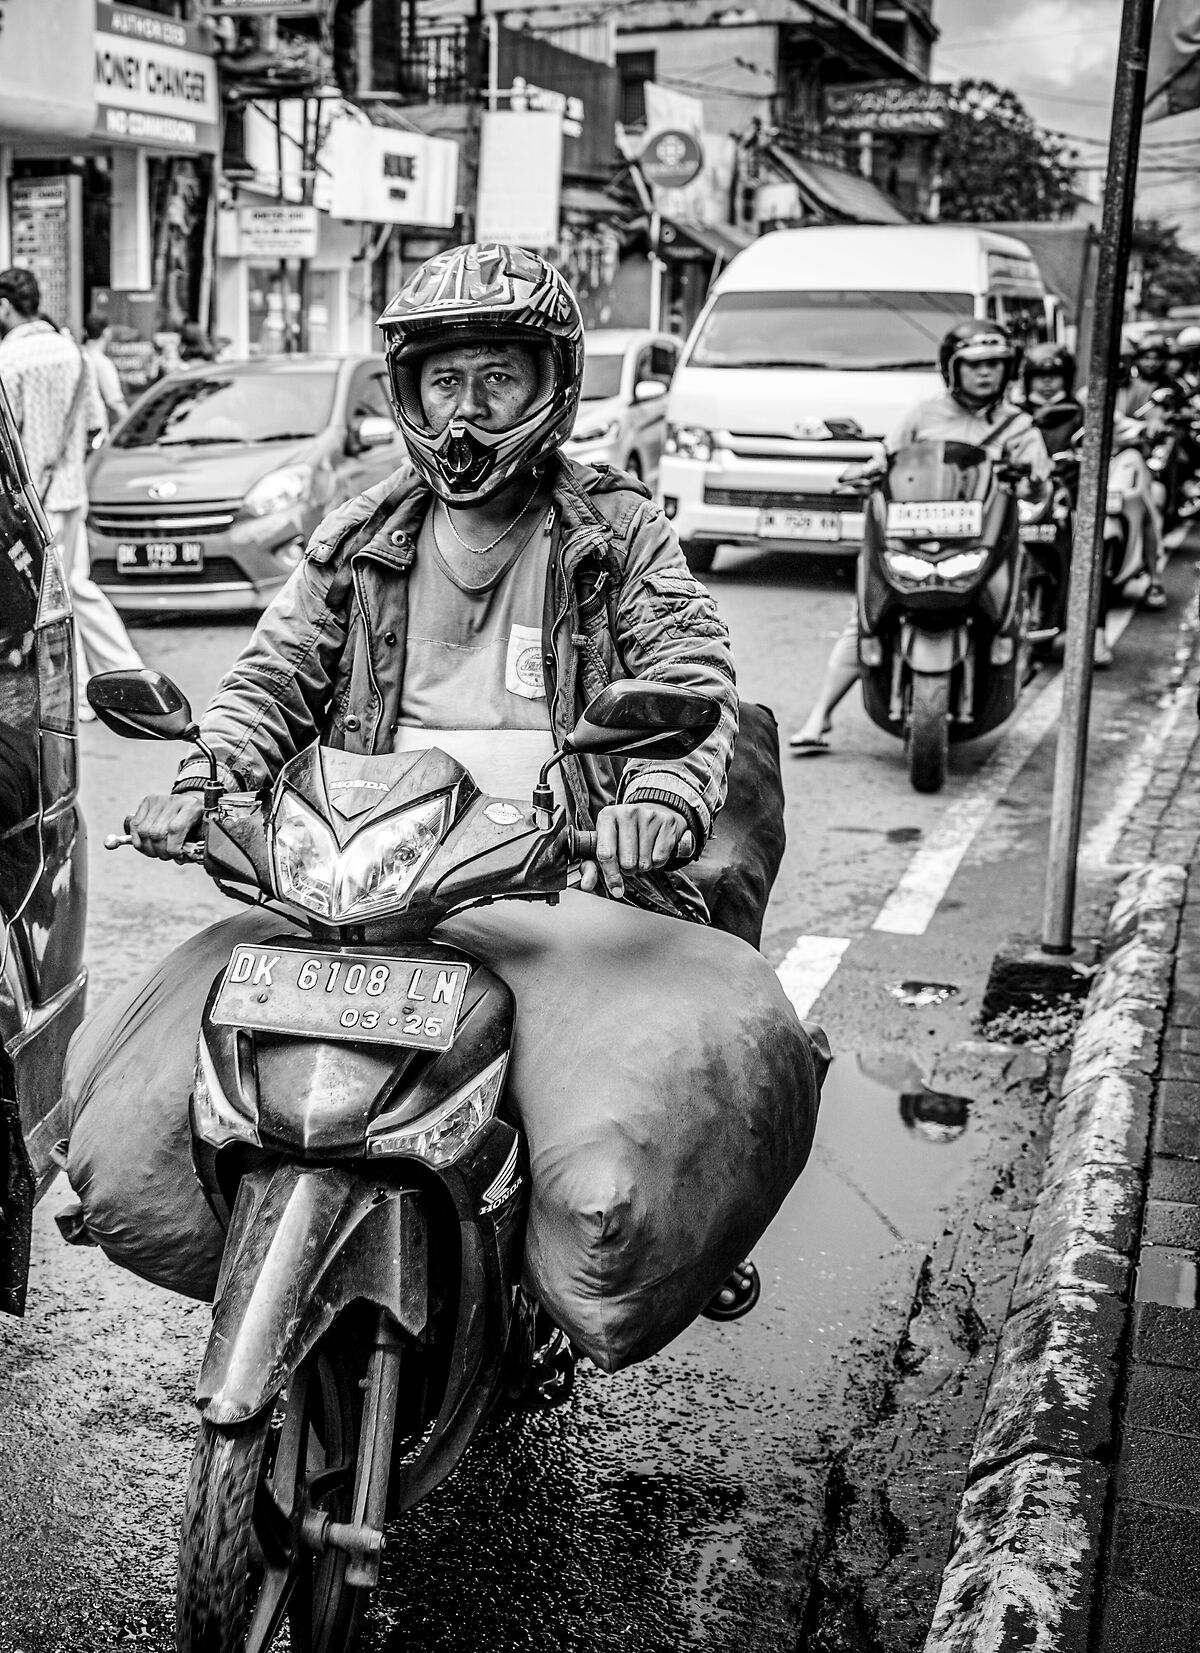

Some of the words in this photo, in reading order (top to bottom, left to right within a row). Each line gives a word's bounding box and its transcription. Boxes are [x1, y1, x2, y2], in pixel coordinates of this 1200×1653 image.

[147, 61, 205, 103] CHANGER
[106, 109, 127, 134] NO
[128, 112, 196, 143] COMMISSION
[118, 544, 137, 563] DK
[329, 779, 390, 792] HONDA
[230, 952, 280, 986] DK
[297, 959, 390, 996] 6108
[407, 968, 458, 1004] LN
[479, 1176, 522, 1215] HONDA
